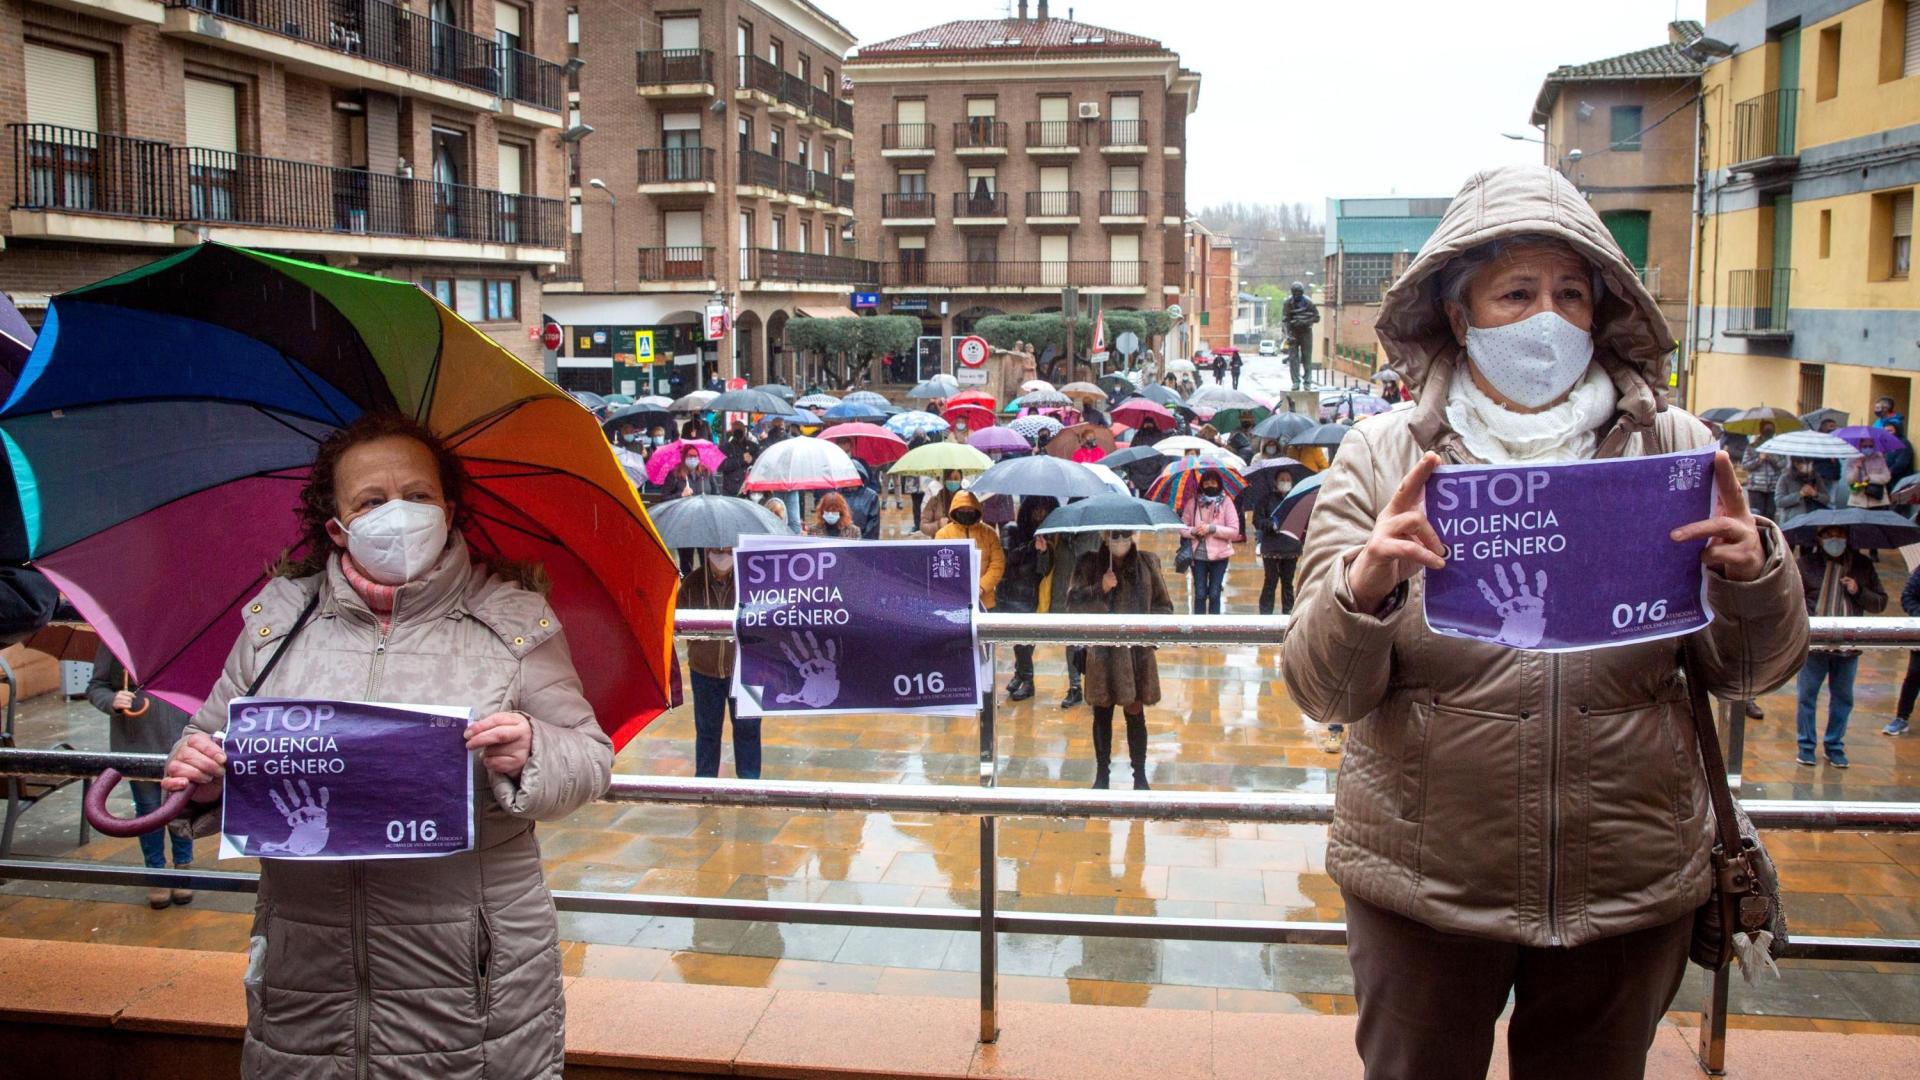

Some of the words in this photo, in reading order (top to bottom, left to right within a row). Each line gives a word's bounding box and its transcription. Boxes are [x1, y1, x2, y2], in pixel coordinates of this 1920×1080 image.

[1436, 470, 1550, 511] STOP
[1437, 510, 1559, 537] VIOLENCIA
[1472, 534, 1566, 560] GÉNERO
[747, 551, 837, 584] STOP
[748, 586, 843, 605] VIOLENCIA
[745, 611, 767, 627] DE
[773, 606, 849, 626] GÉNERO
[1612, 599, 1667, 628] 016
[893, 671, 945, 696] 016
[237, 704, 336, 733] STOP
[235, 736, 338, 754] VIOLENCIA
[233, 760, 257, 775] DE
[264, 755, 345, 775] GÉNERO
[386, 819, 438, 843] 016
